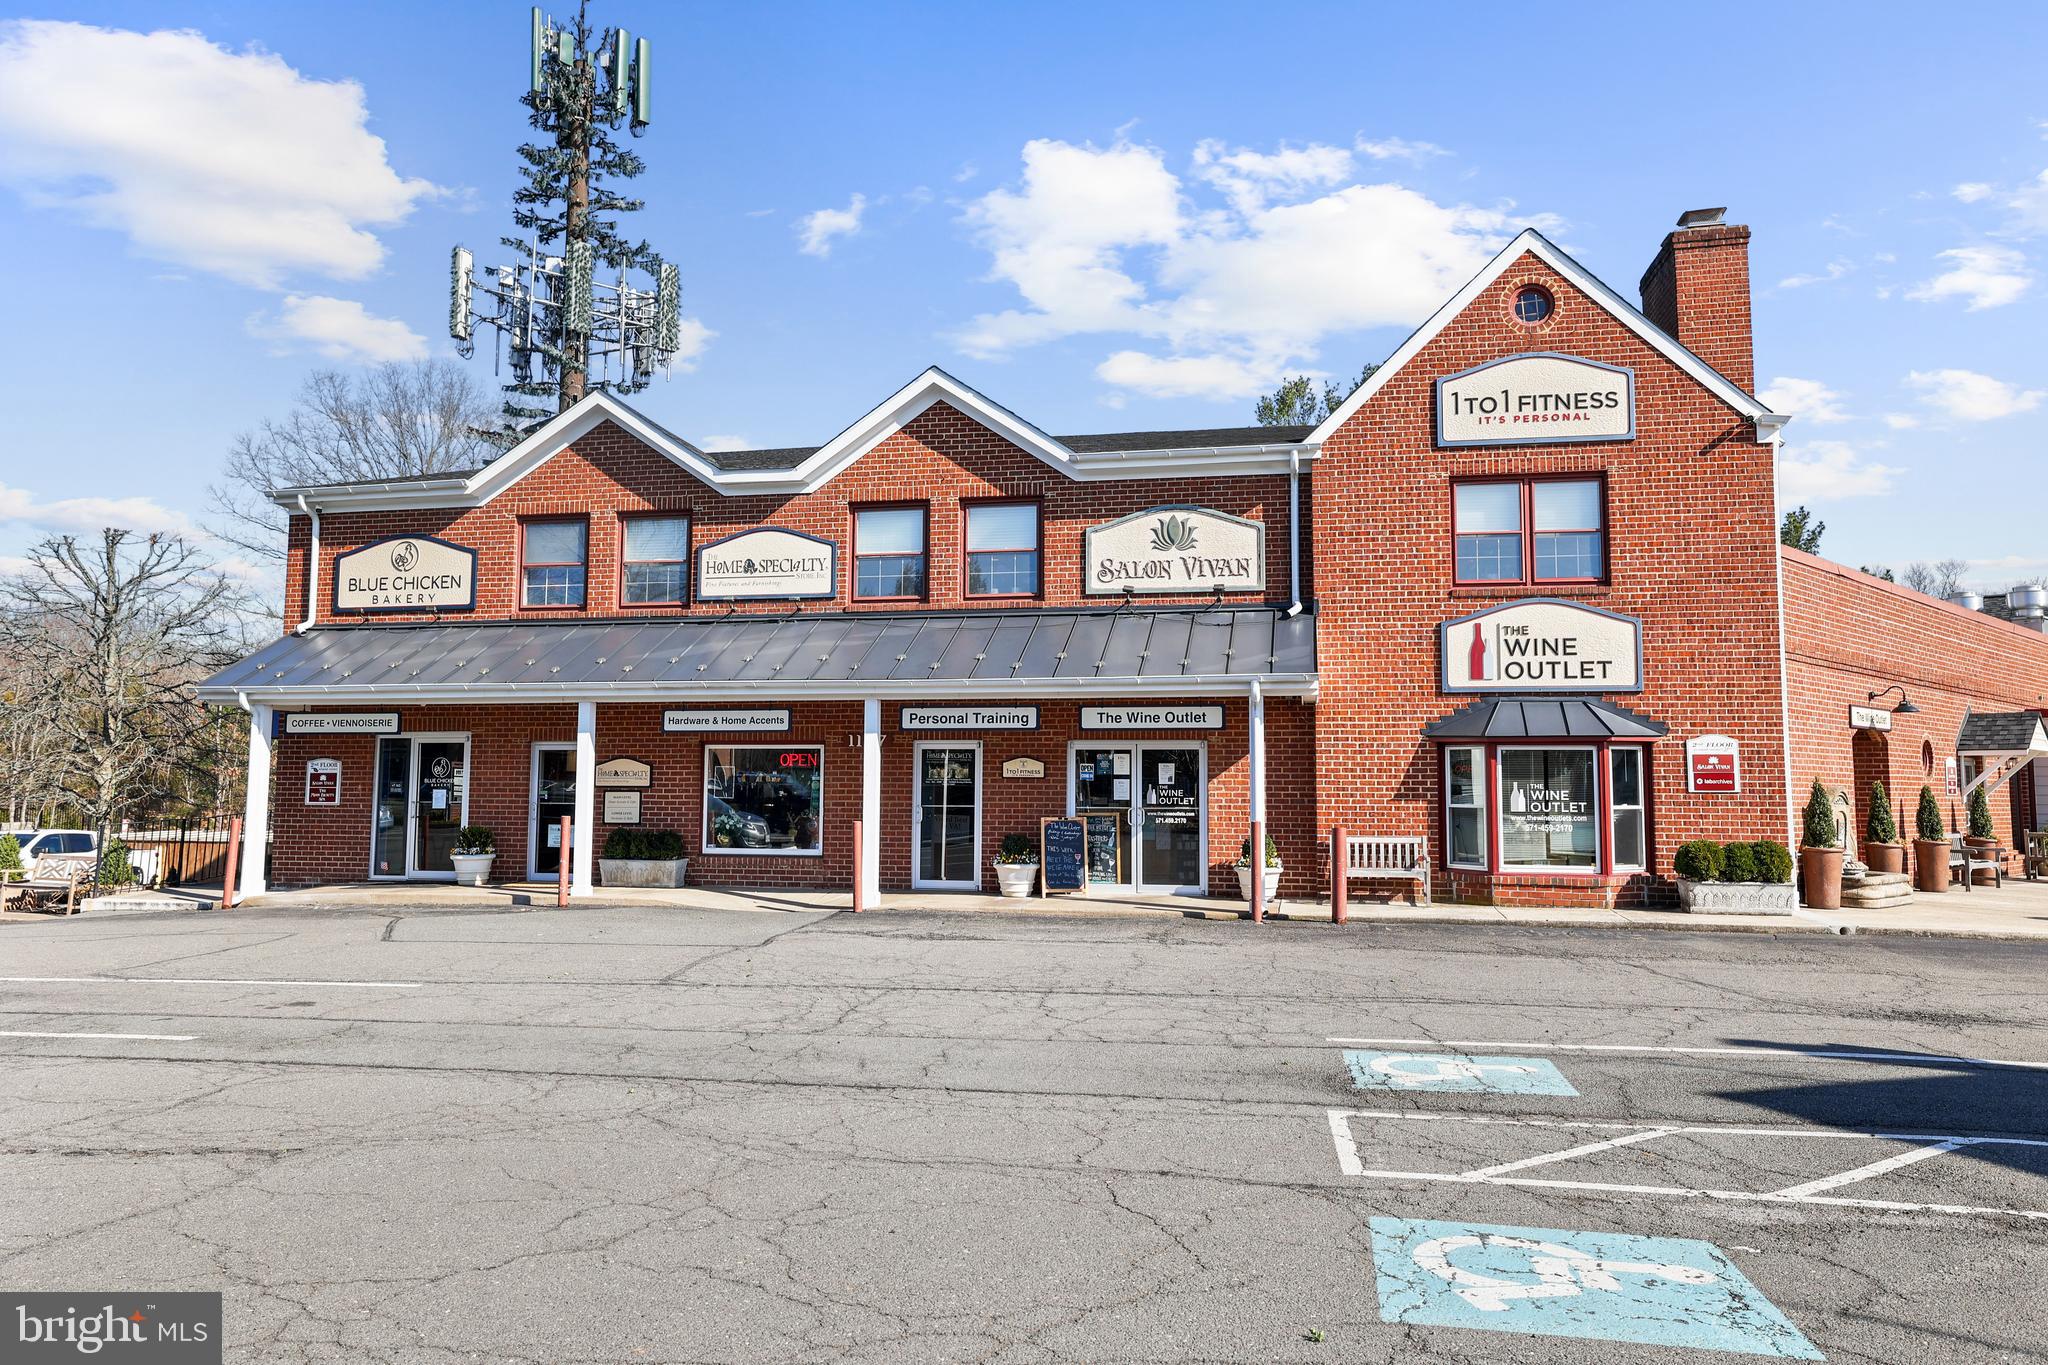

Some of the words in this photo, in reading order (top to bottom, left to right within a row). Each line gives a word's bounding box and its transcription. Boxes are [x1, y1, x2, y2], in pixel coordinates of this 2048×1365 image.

[1518, 391, 1619, 413] FITNESS
[1479, 416, 1506, 425] IT'S
[1513, 412, 1591, 424] PERSONAL
[348, 577, 389, 592] BLUE
[392, 574, 462, 591] CHICKEN
[372, 593, 436, 604] BAKERY
[1502, 625, 1529, 636] THE
[1504, 638, 1578, 656] WINE
[1505, 661, 1613, 680] OUTLET
[291, 719, 325, 728] COFFEE
[332, 718, 393, 728] VIENNOISERIE
[668, 716, 710, 725] Hardware
[712, 716, 719, 725] &
[721, 716, 747, 725] Home
[749, 716, 785, 725] Accents
[909, 712, 968, 724] Personal
[973, 712, 1029, 726] Training
[1097, 712, 1122, 724] The
[1126, 712, 1160, 723] Wine
[1164, 711, 1207, 723] Outlet
[848, 734, 887, 747] 117
[780, 753, 818, 767] OPEN
[1081, 764, 1094, 772] OPEN
[1159, 789, 1184, 797] WINE
[1530, 790, 1570, 801] WINE
[1159, 797, 1195, 805] OUTLET
[1530, 802, 1587, 813] OUTLET
